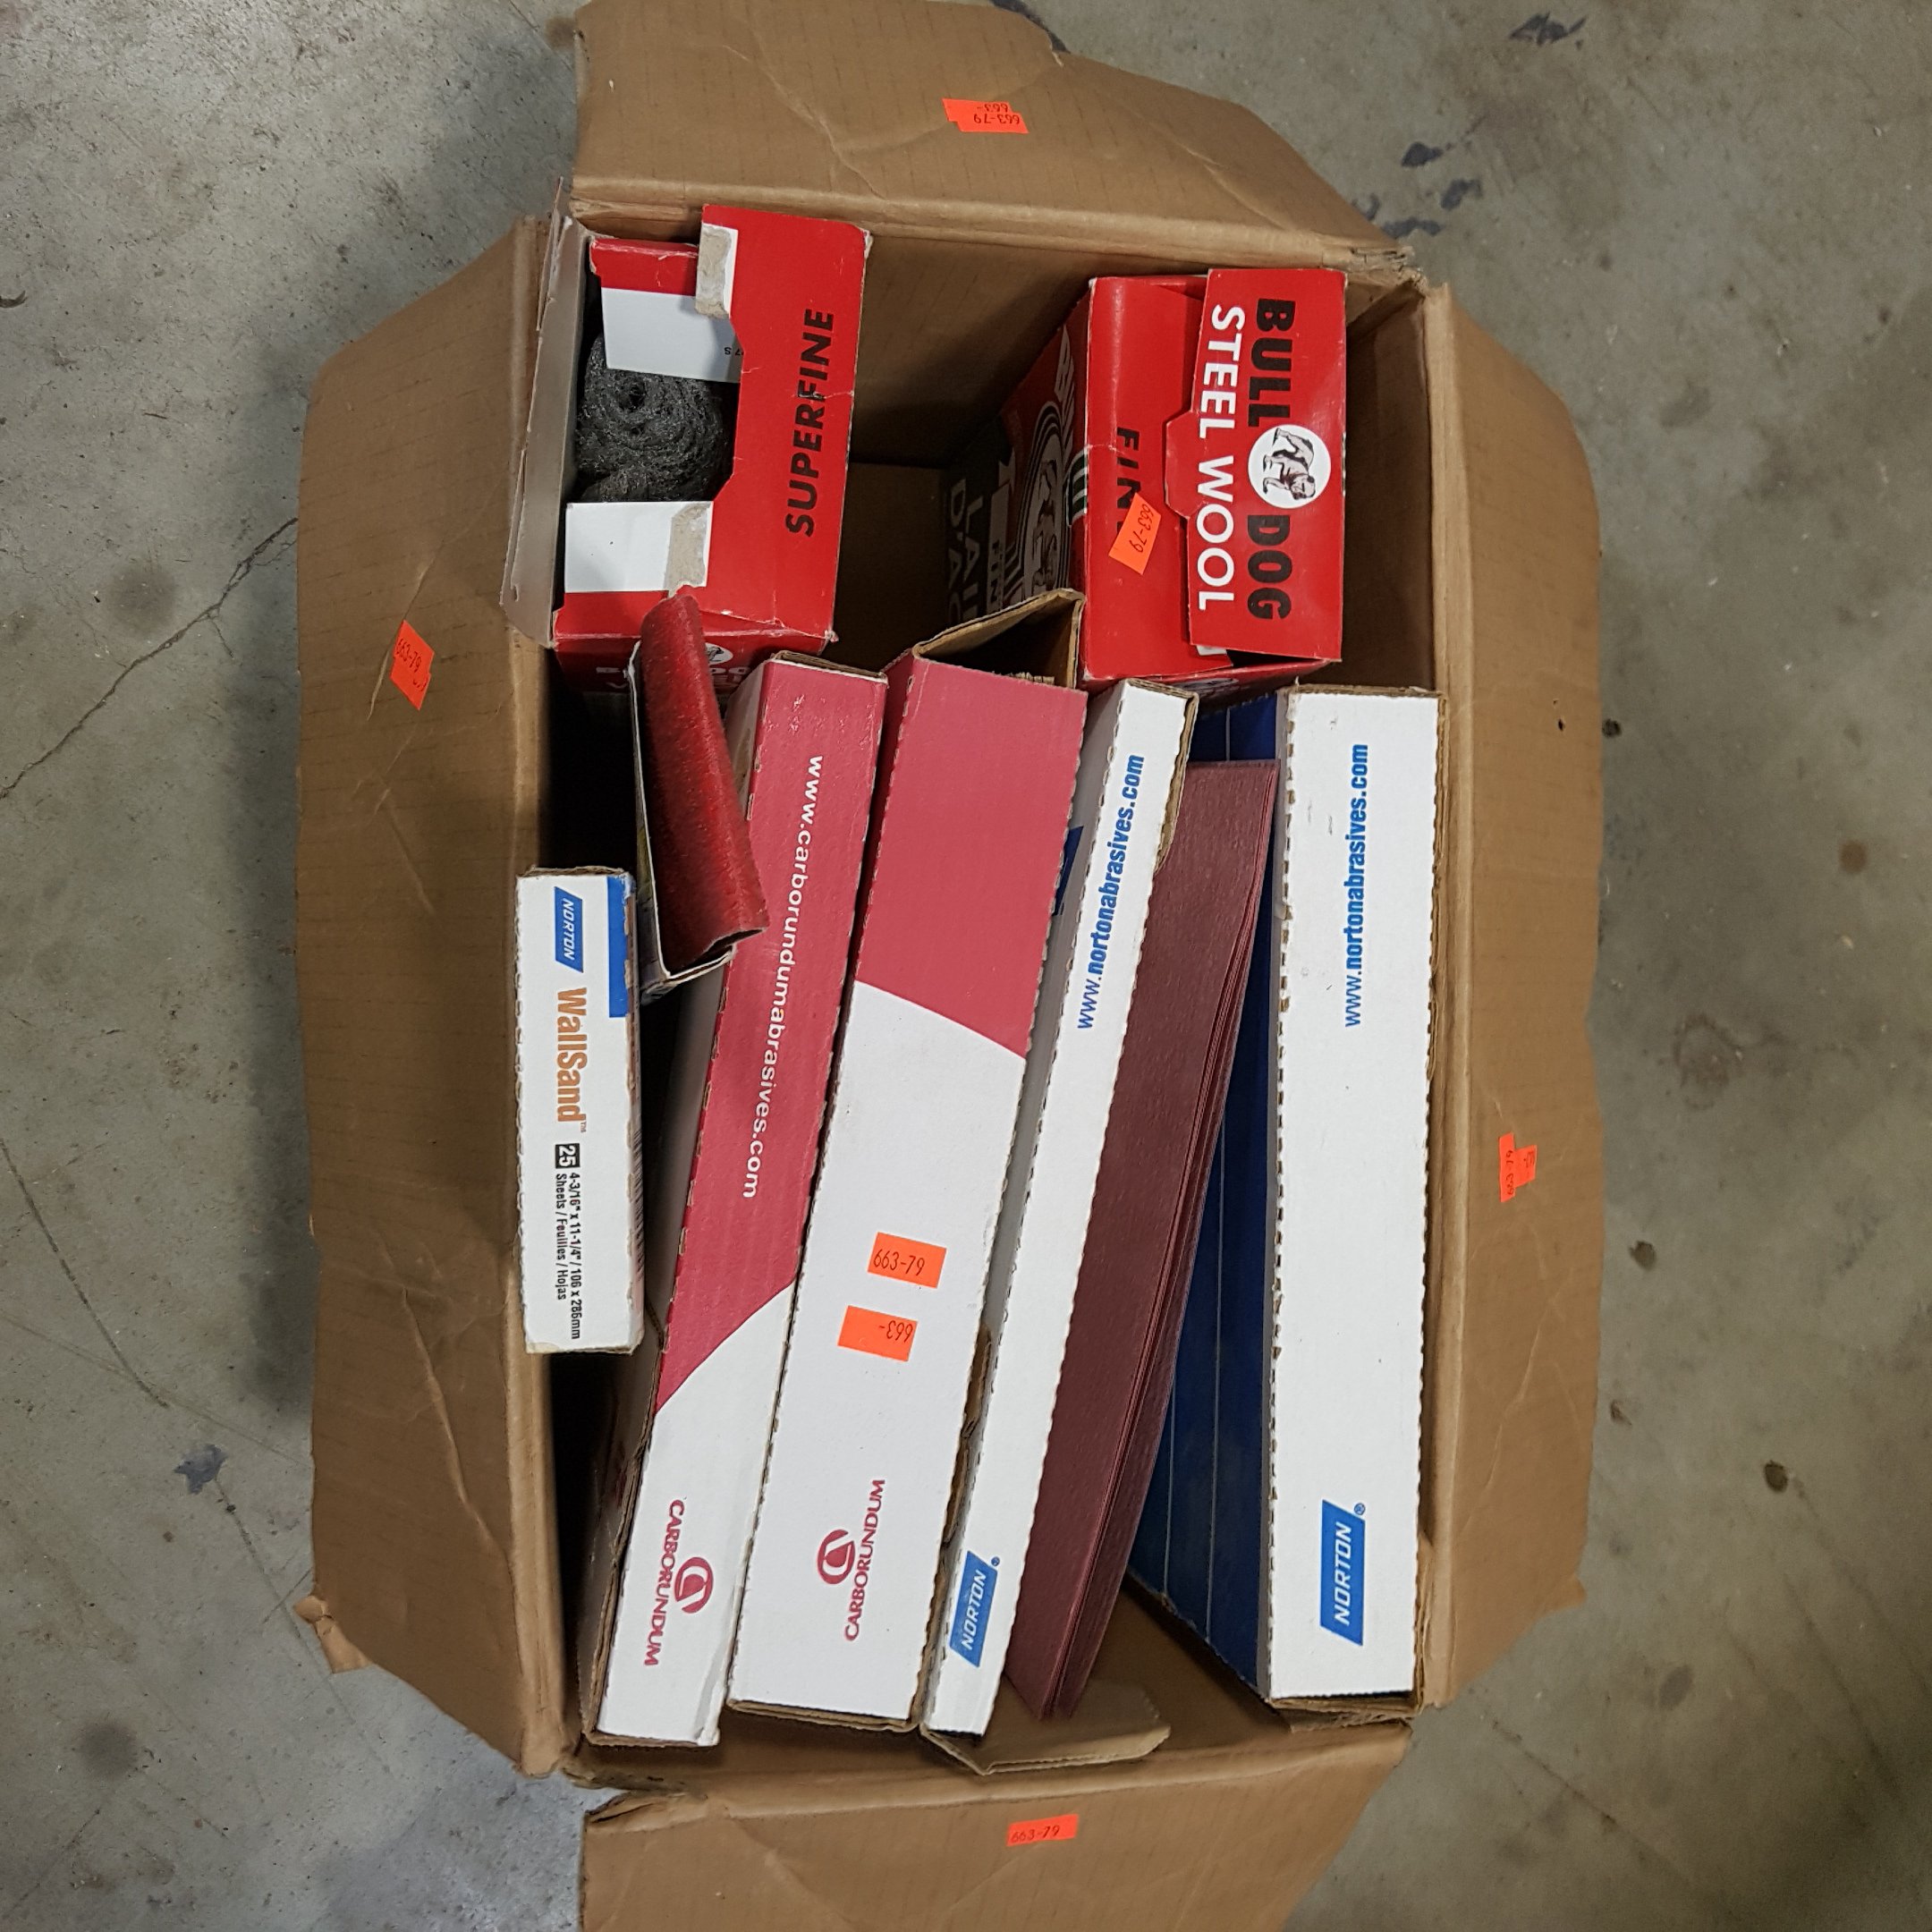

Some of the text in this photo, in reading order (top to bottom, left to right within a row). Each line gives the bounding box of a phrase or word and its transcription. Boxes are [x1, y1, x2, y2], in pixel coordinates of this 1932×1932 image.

[973, 113, 1021, 125] 663-79
[785, 308, 834, 537] SUPERFINE
[1196, 304, 1245, 611] STEEL WOOL
[1247, 297, 1296, 621] BULL DOG
[1117, 427, 1141, 534] FIN
[1129, 504, 1154, 553] 663-79
[563, 897, 575, 961] NORTON
[1077, 754, 1145, 1030] www.nortonabrasives.com
[1343, 743, 1368, 1028] www.nortonabrasives.com
[742, 755, 823, 1199] www.carborundumabrasives.com
[555, 1173, 567, 1209] Sheets
[558, 1145, 576, 1167] 25
[555, 1269, 568, 1300] Hojas
[556, 1219, 568, 1260] Feuilles
[873, 1249, 925, 1276] 663-79
[644, 1499, 685, 1666] CARBORUNDUM
[844, 1479, 886, 1641] CARBORUNDUM
